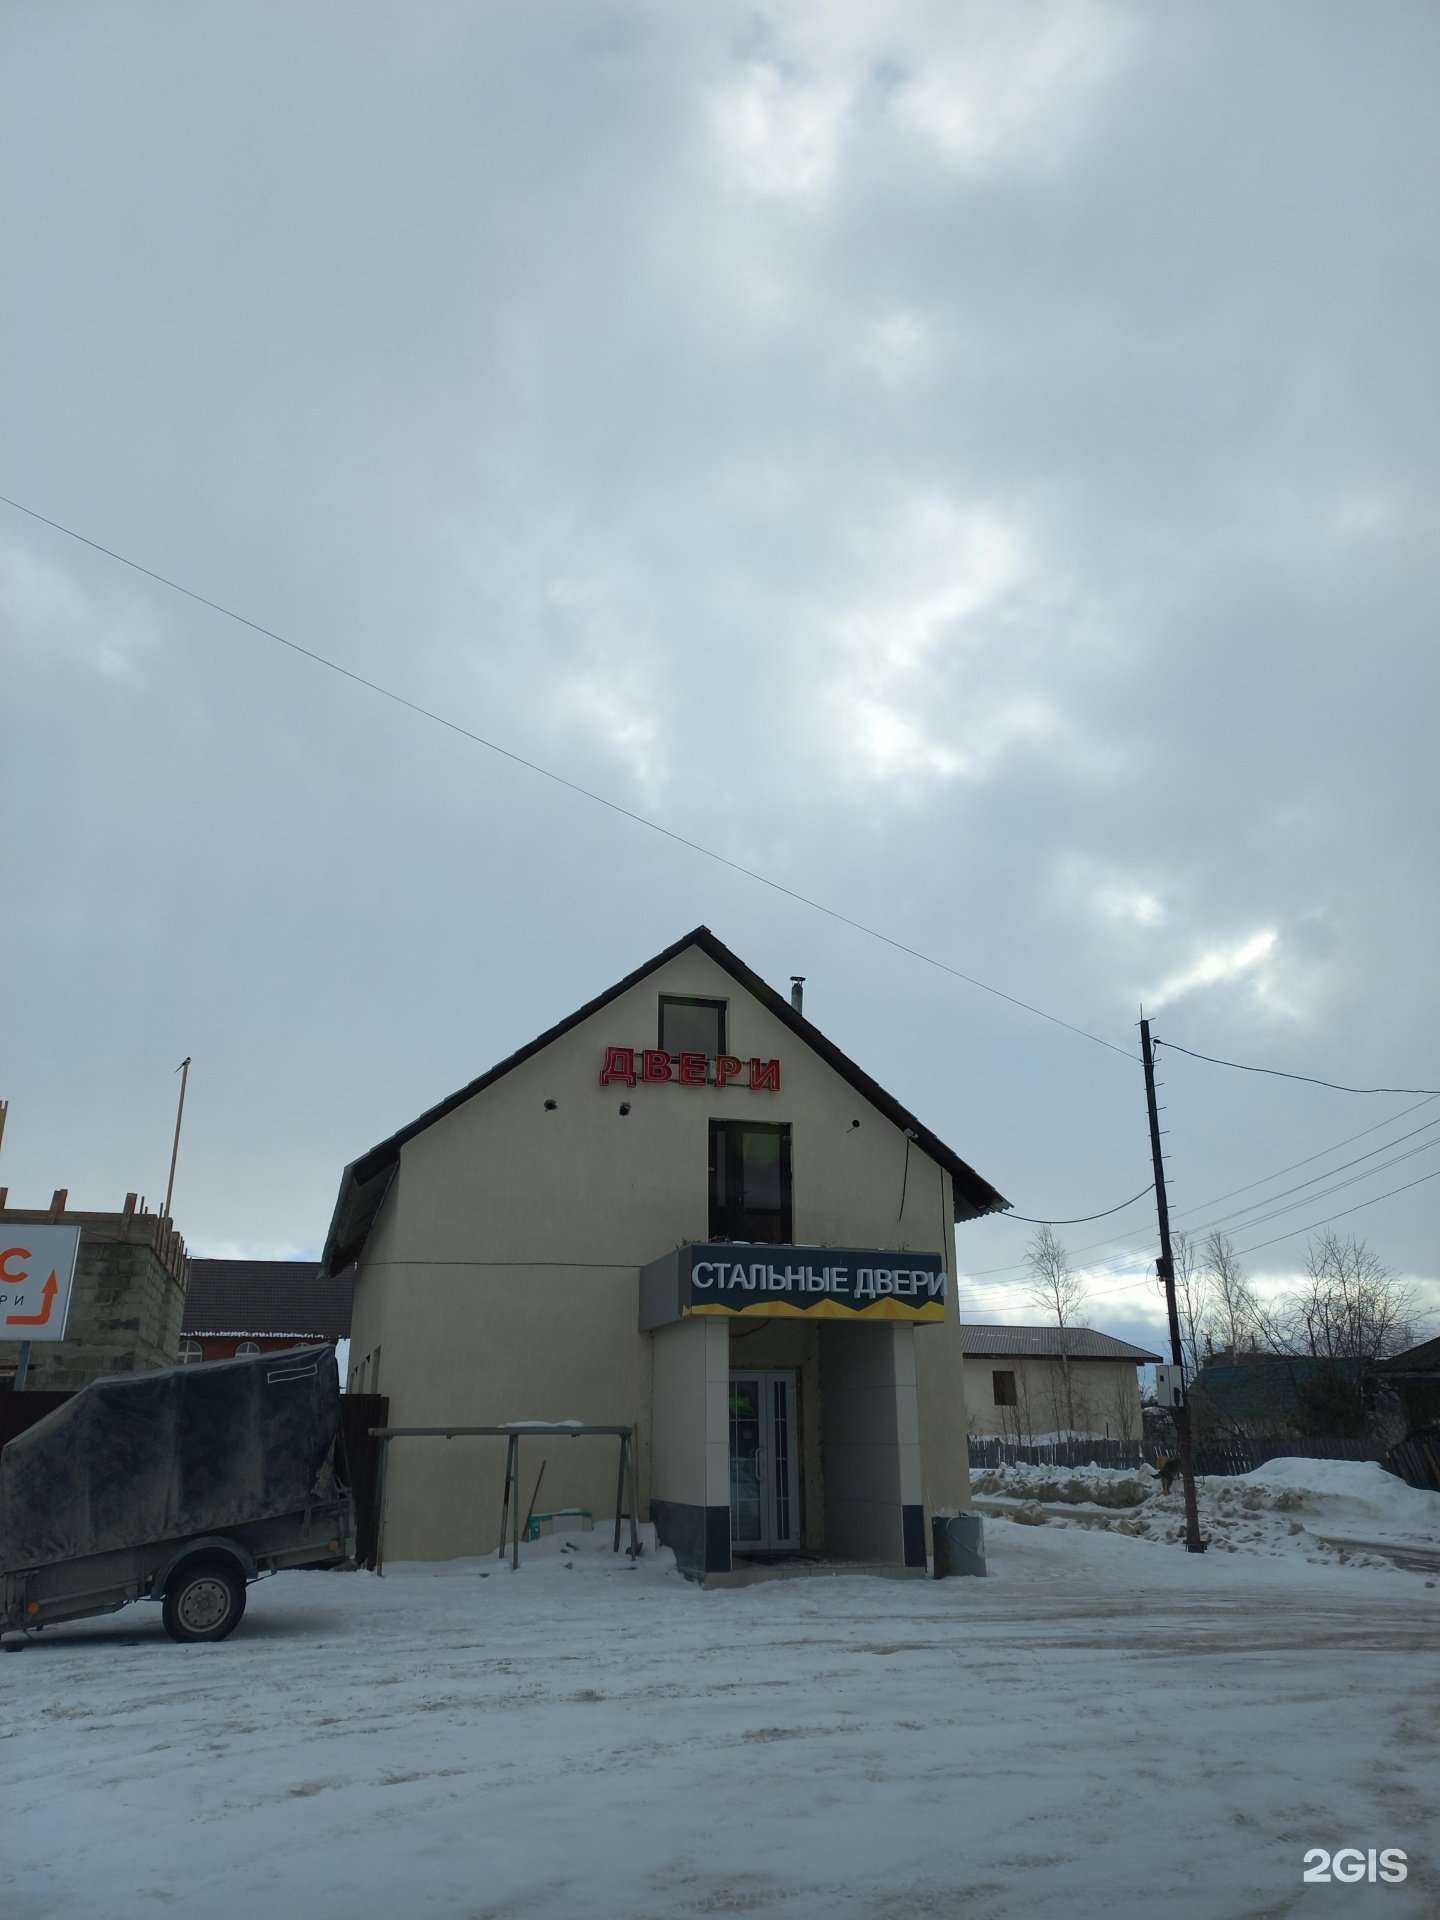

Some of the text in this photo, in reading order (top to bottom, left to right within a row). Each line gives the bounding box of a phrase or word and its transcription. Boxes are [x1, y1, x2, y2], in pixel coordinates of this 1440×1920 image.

[600, 1046, 781, 1092] ДВЕРИ
[691, 1262, 948, 1299] СТАЛЬНЫЕ ДВЕРИ
